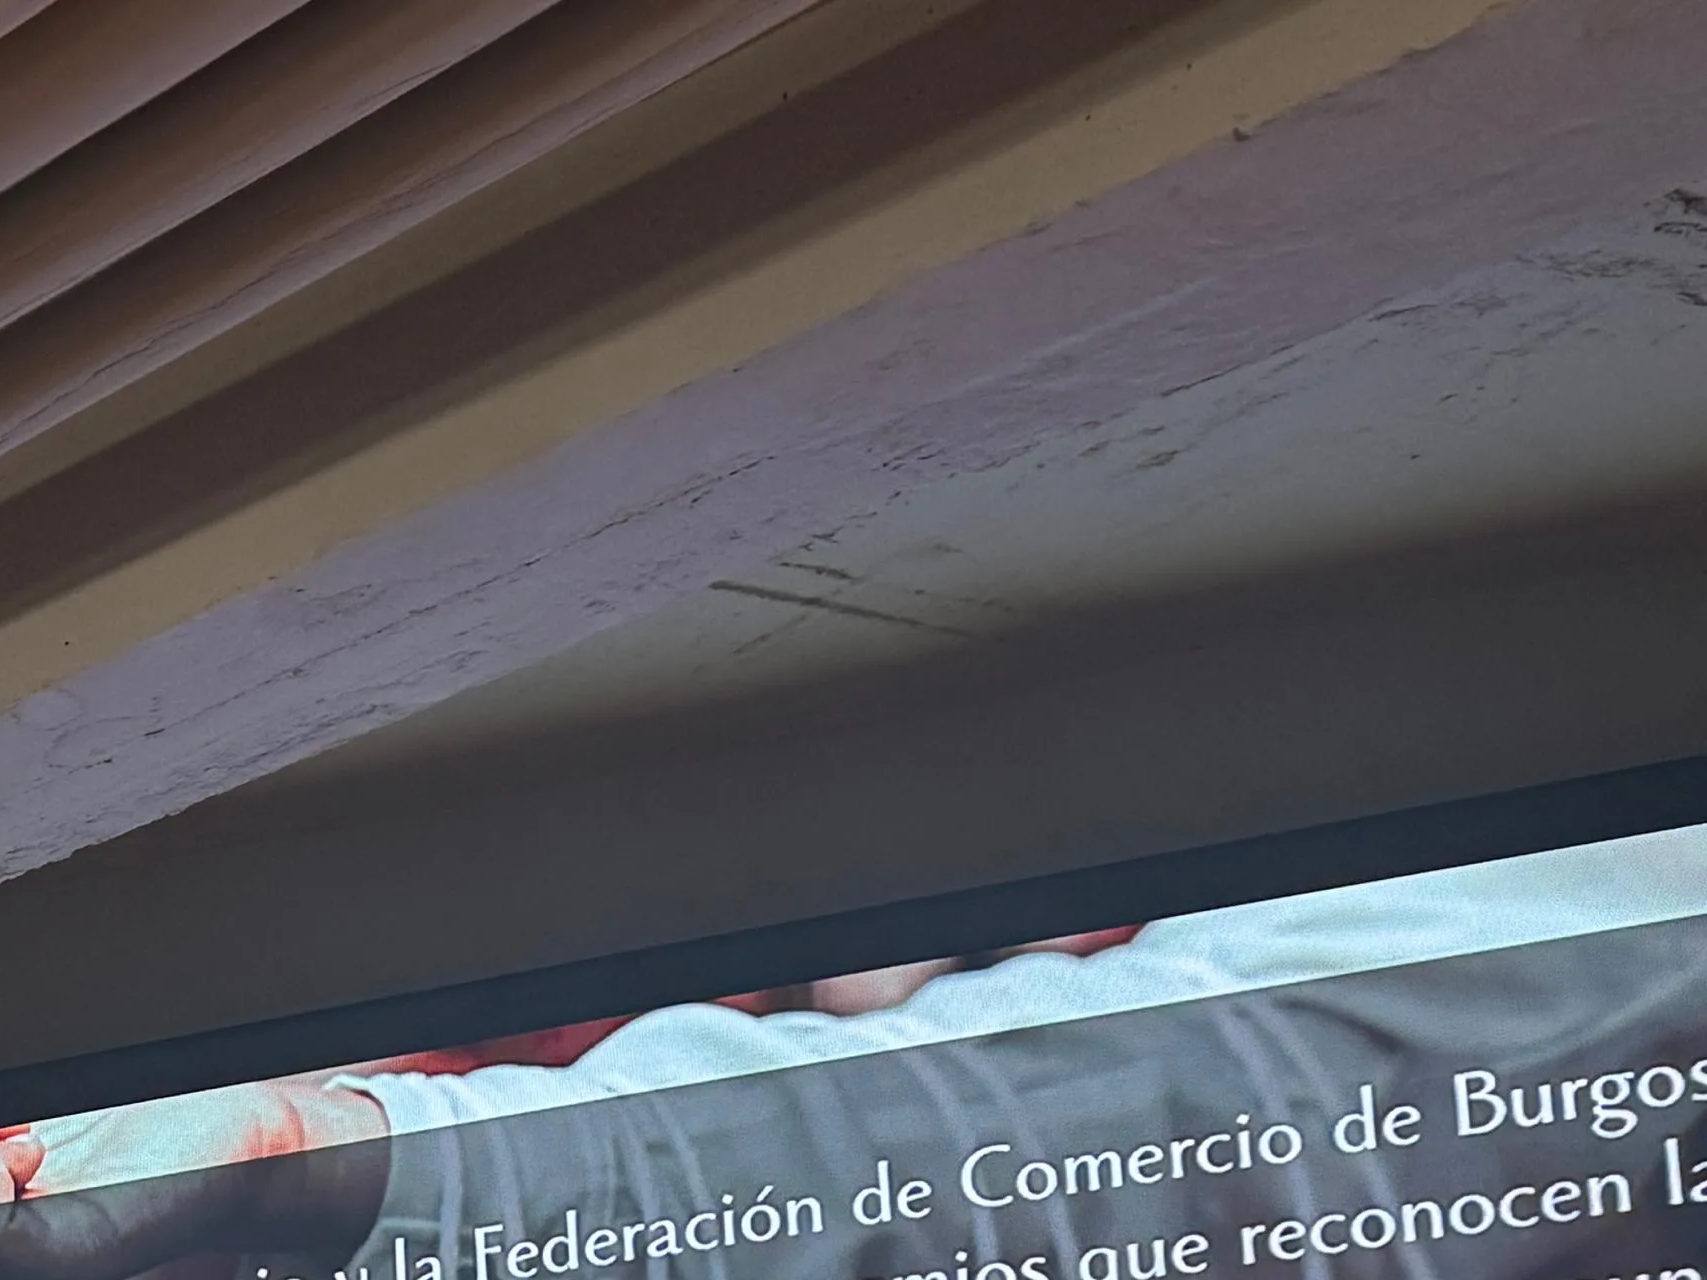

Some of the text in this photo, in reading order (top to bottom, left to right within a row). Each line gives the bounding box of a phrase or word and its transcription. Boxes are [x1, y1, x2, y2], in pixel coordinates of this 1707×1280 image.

[853, 1161, 931, 1224] de
[961, 1114, 1301, 1206] Comercio
[1334, 1085, 1420, 1152] de
[1242, 1175, 1631, 1264] reconocen
